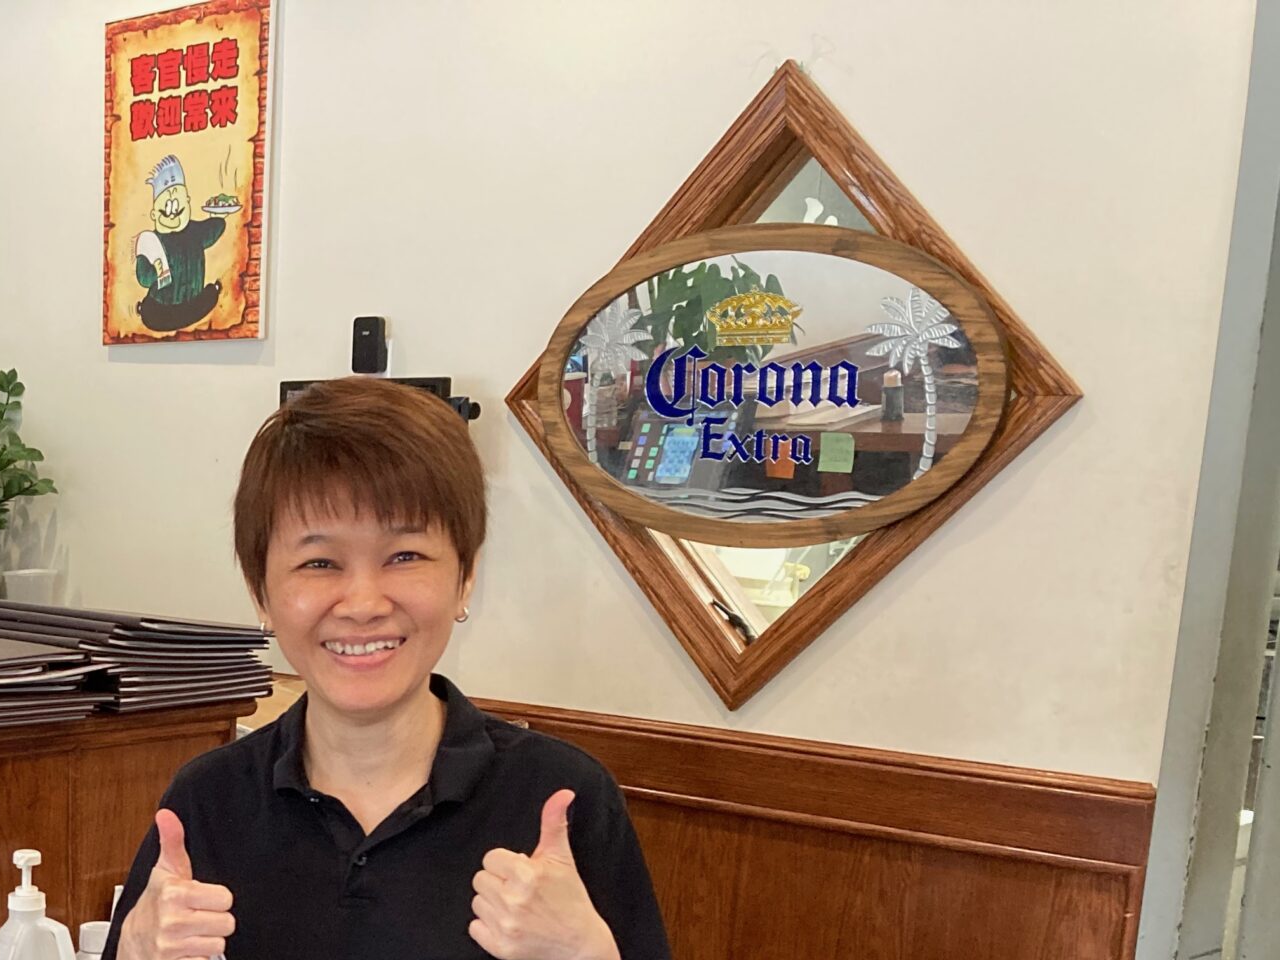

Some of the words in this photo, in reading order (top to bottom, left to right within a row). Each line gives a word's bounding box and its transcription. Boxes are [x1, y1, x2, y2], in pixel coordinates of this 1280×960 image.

[130, 37, 239, 97] 客官慢走
[129, 85, 239, 142] 歡迎常來
[644, 343, 862, 427] Corona
[699, 417, 814, 464] Extra
